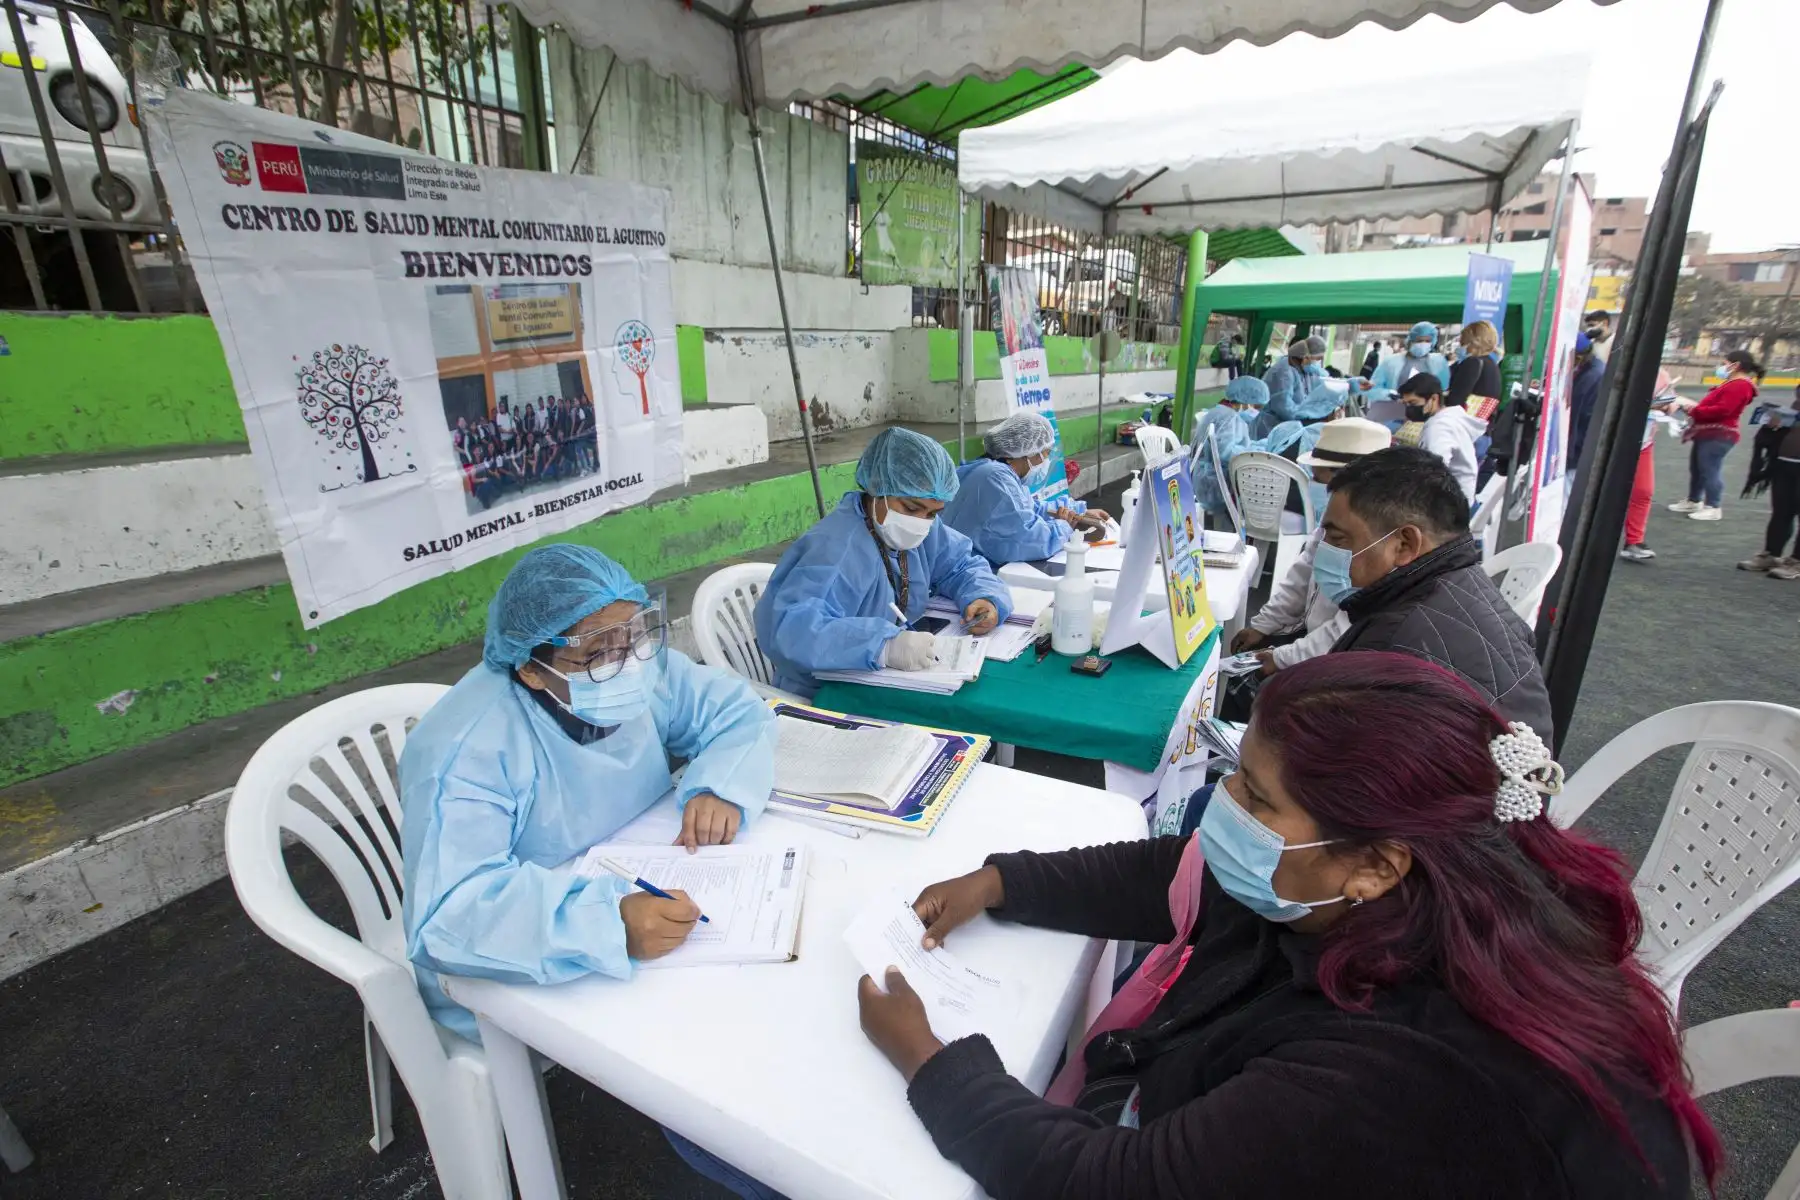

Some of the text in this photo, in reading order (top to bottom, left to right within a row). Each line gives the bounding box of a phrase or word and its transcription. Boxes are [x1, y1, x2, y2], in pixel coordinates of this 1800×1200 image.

[262, 160, 298, 176] PERÚ
[308, 164, 399, 183] Ministerio de Salud
[404, 160, 444, 175] Dirección
[455, 168, 478, 180] Redes
[406, 175, 481, 192] Integradas de Salud
[408, 187, 448, 201] Lima Este
[222, 203, 666, 246] CENTRO DE SALUD MENTAL COMUNITARIO EL AGUSTINO
[400, 250, 593, 279] BIENVENIDOS
[1474, 280, 1503, 303] MINSA
[403, 534, 464, 562] SALUD
[466, 511, 526, 543] MENTAL
[534, 485, 604, 517] BIENESTAR
